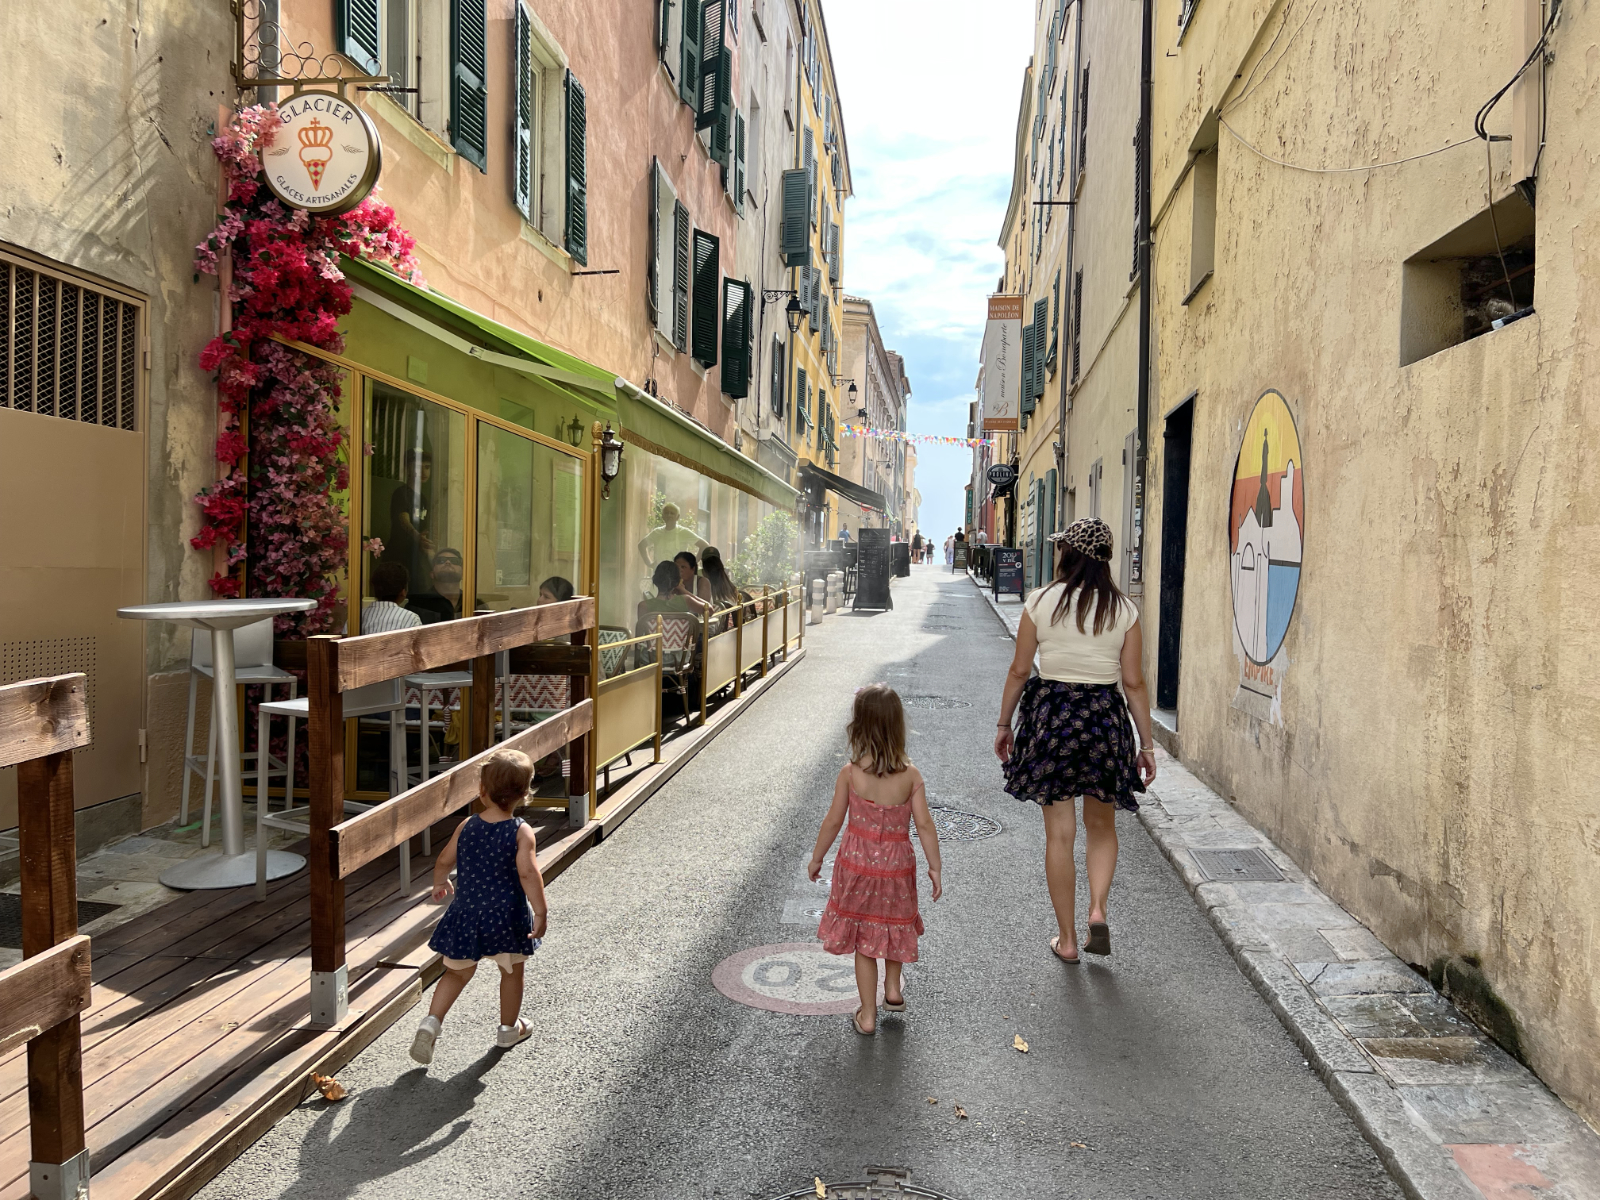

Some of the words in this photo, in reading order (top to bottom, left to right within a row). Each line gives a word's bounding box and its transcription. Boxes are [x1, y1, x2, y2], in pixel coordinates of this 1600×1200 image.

[280, 98, 354, 125] GLACIER
[276, 175, 304, 201] GLACES
[305, 174, 357, 204] ARTISANALES
[990, 311, 1019, 319] NAPOLÉON
[753, 960, 858, 993] 20
